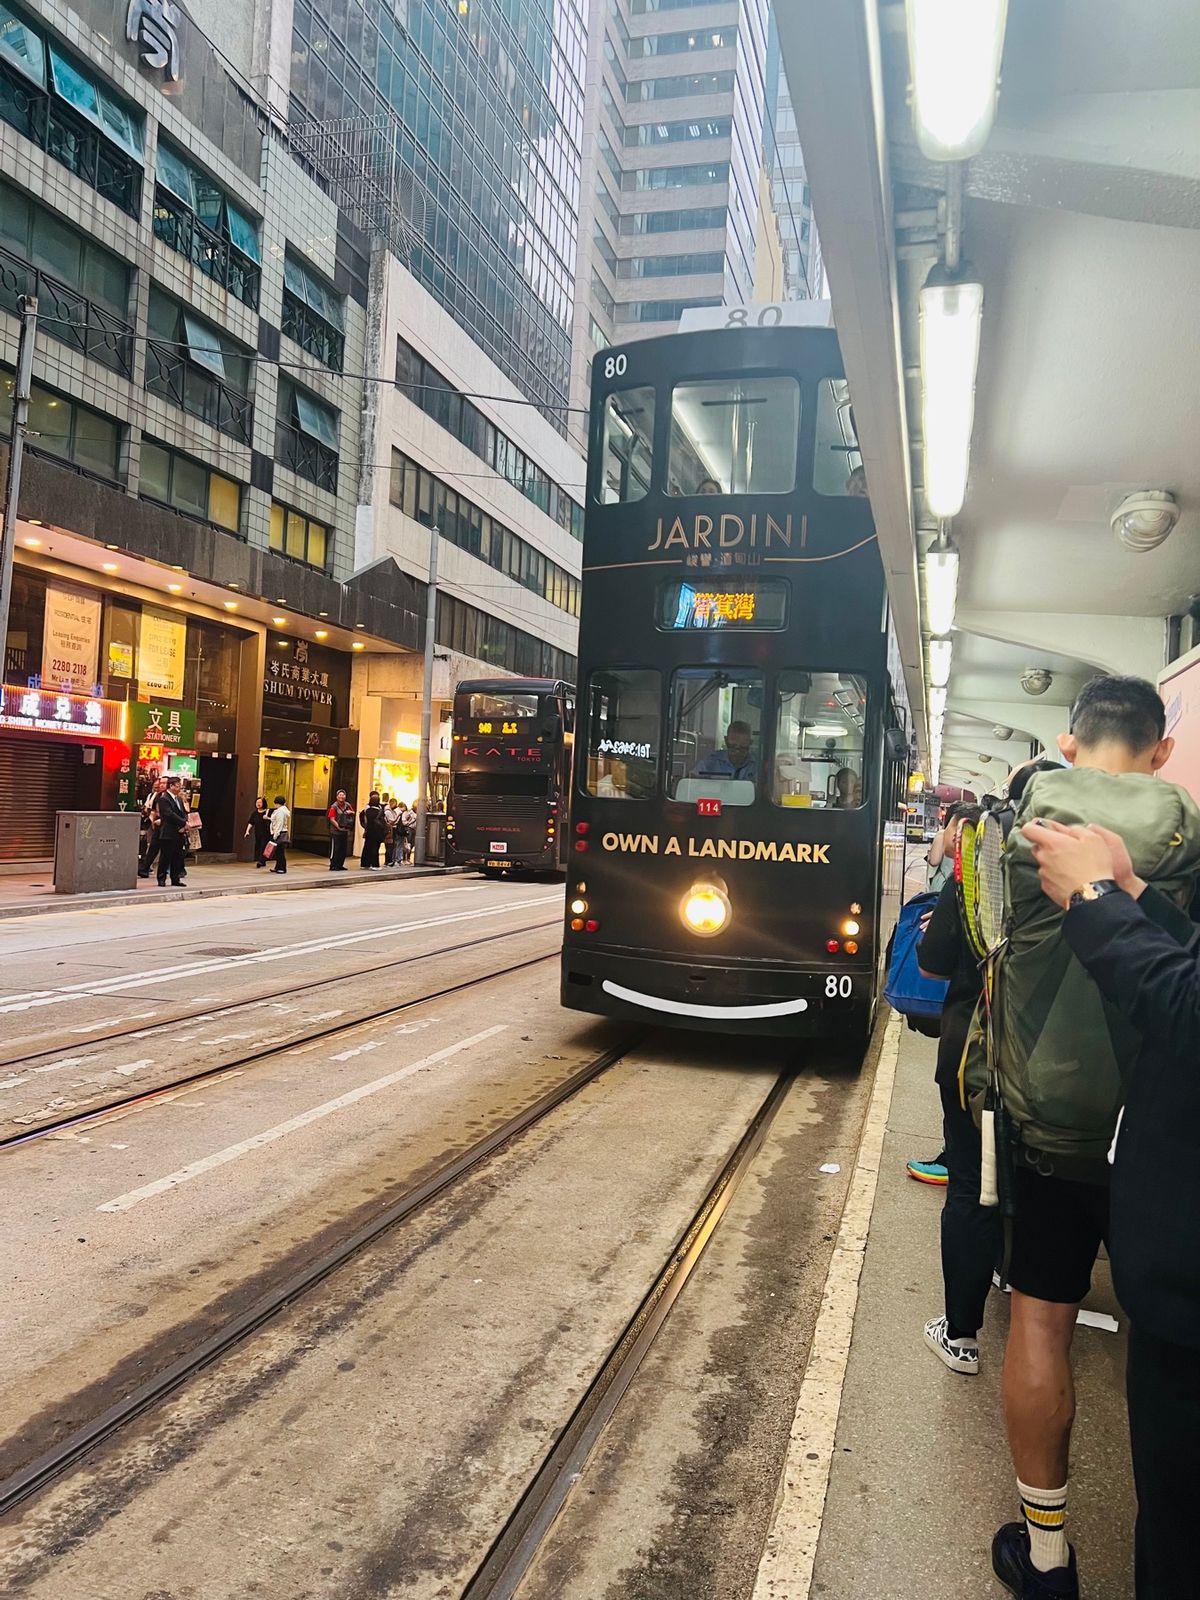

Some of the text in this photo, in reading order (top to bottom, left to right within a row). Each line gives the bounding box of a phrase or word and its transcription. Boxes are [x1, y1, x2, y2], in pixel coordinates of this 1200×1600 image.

[604, 353, 628, 379] 80
[647, 513, 808, 551] JARDINI
[52, 659, 87, 676] 2280 2118
[263, 679, 333, 706] SHUM TOWER
[148, 708, 181, 733] 文具
[146, 732, 181, 743] STATIONERY
[463, 747, 542, 756] KATE
[699, 802, 720, 814] 114
[602, 832, 831, 864] OWN A LANDMARK
[824, 974, 853, 999] 80
